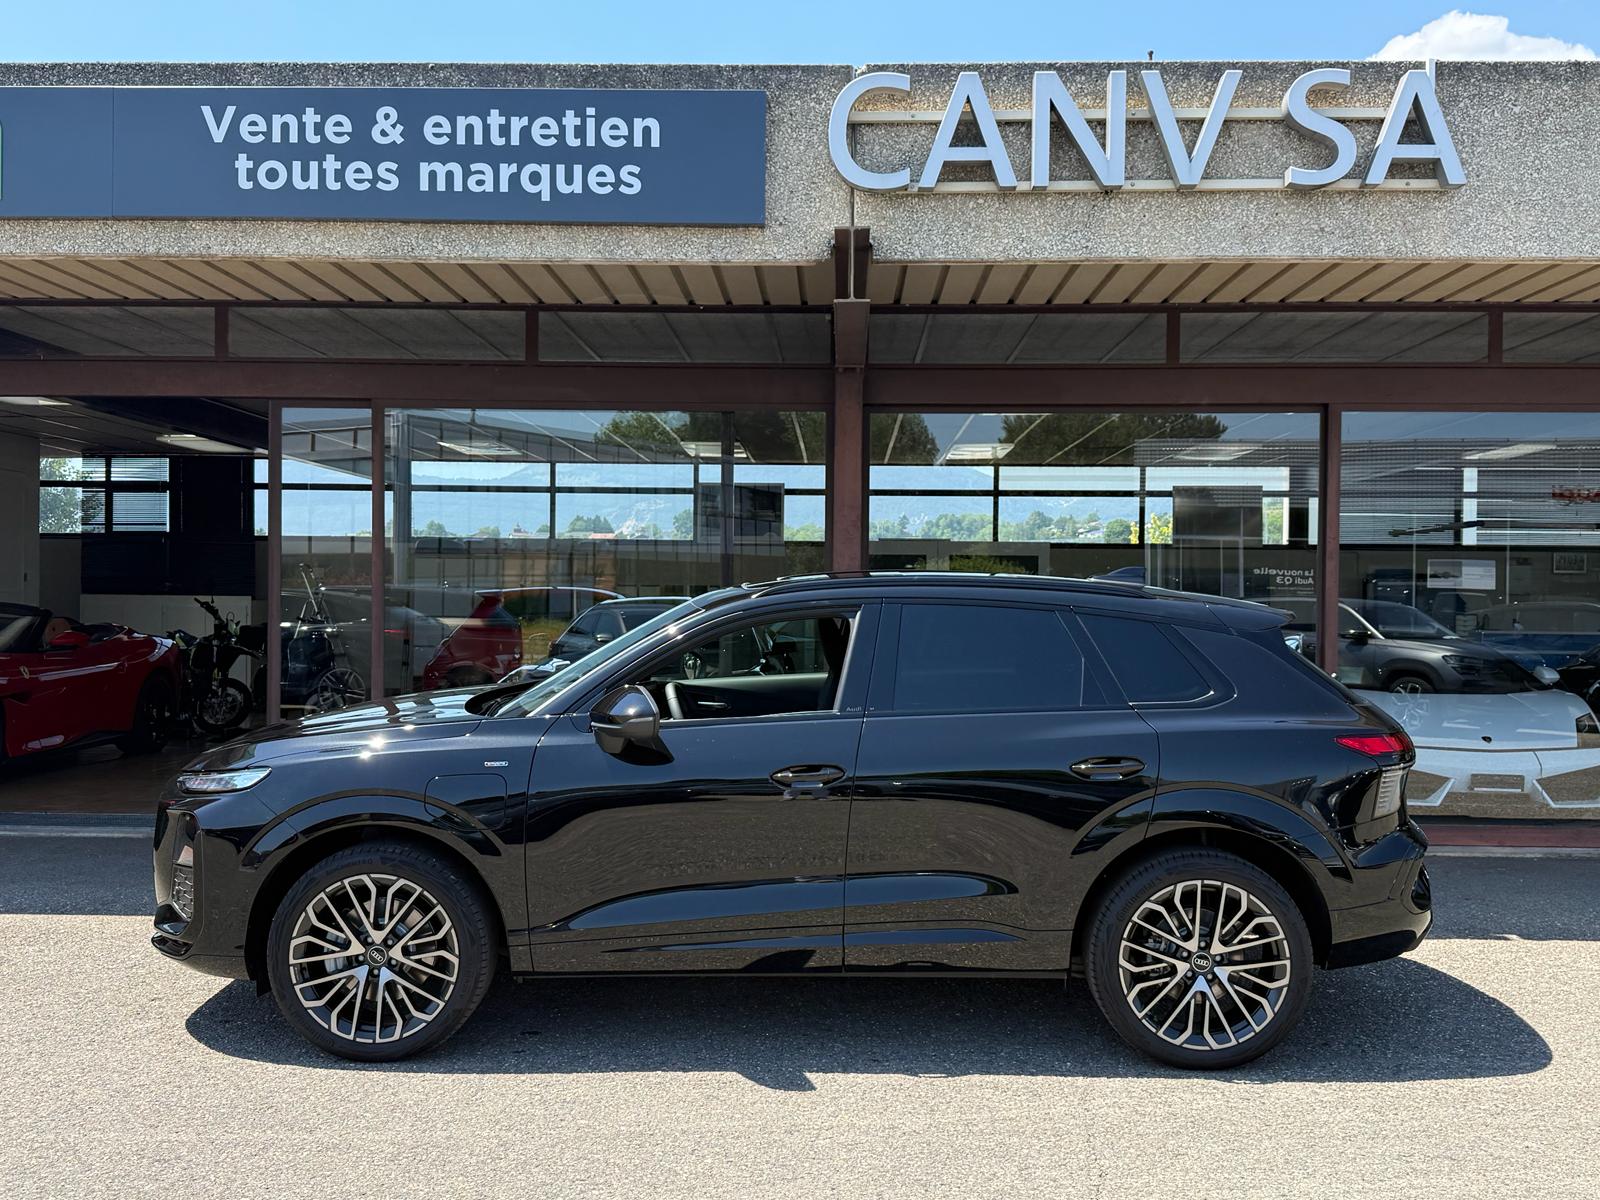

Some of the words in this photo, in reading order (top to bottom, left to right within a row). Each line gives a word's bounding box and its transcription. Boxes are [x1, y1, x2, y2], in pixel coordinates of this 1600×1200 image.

[200, 105, 352, 145] Vente
[371, 105, 405, 145] &
[423, 107, 661, 148] entretien
[828, 68, 1243, 190] CANV
[1282, 67, 1467, 188] SA
[235, 153, 399, 192] toutes
[419, 161, 642, 202] marques
